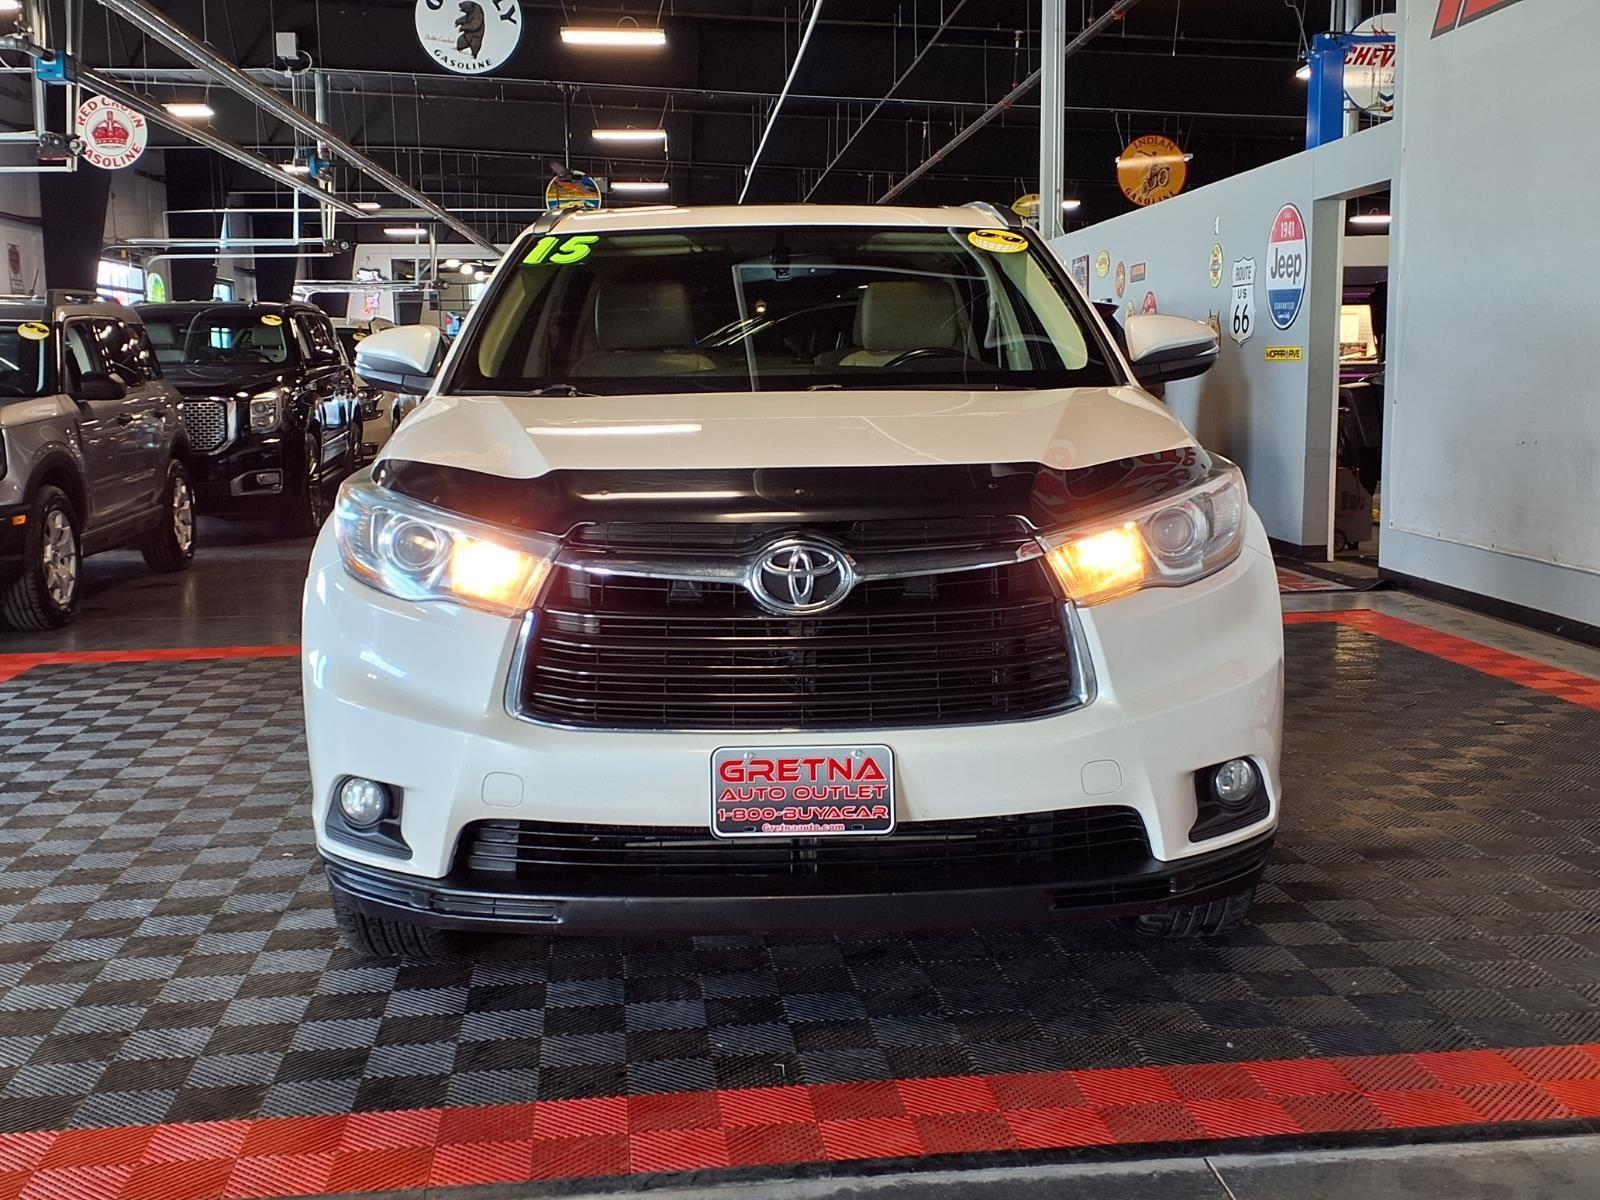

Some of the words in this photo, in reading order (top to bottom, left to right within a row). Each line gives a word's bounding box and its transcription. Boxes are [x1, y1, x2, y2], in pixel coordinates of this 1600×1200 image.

[434, 49, 493, 70] GASOLINE
[1344, 44, 1395, 68] CHEV
[78, 101, 98, 126] RED
[1133, 136, 1176, 151] INDIAN
[1280, 221, 1295, 238] 1941
[522, 235, 600, 264] 15
[1235, 266, 1252, 281] ROUTE
[1270, 247, 1302, 284] Jeep
[1237, 288, 1247, 299] US
[1233, 303, 1250, 334] 66
[719, 757, 887, 783] GRETNA
[718, 786, 786, 802] AUTO
[793, 784, 888, 801] OUTLET
[718, 805, 889, 821] 1-800-BUYACAR
